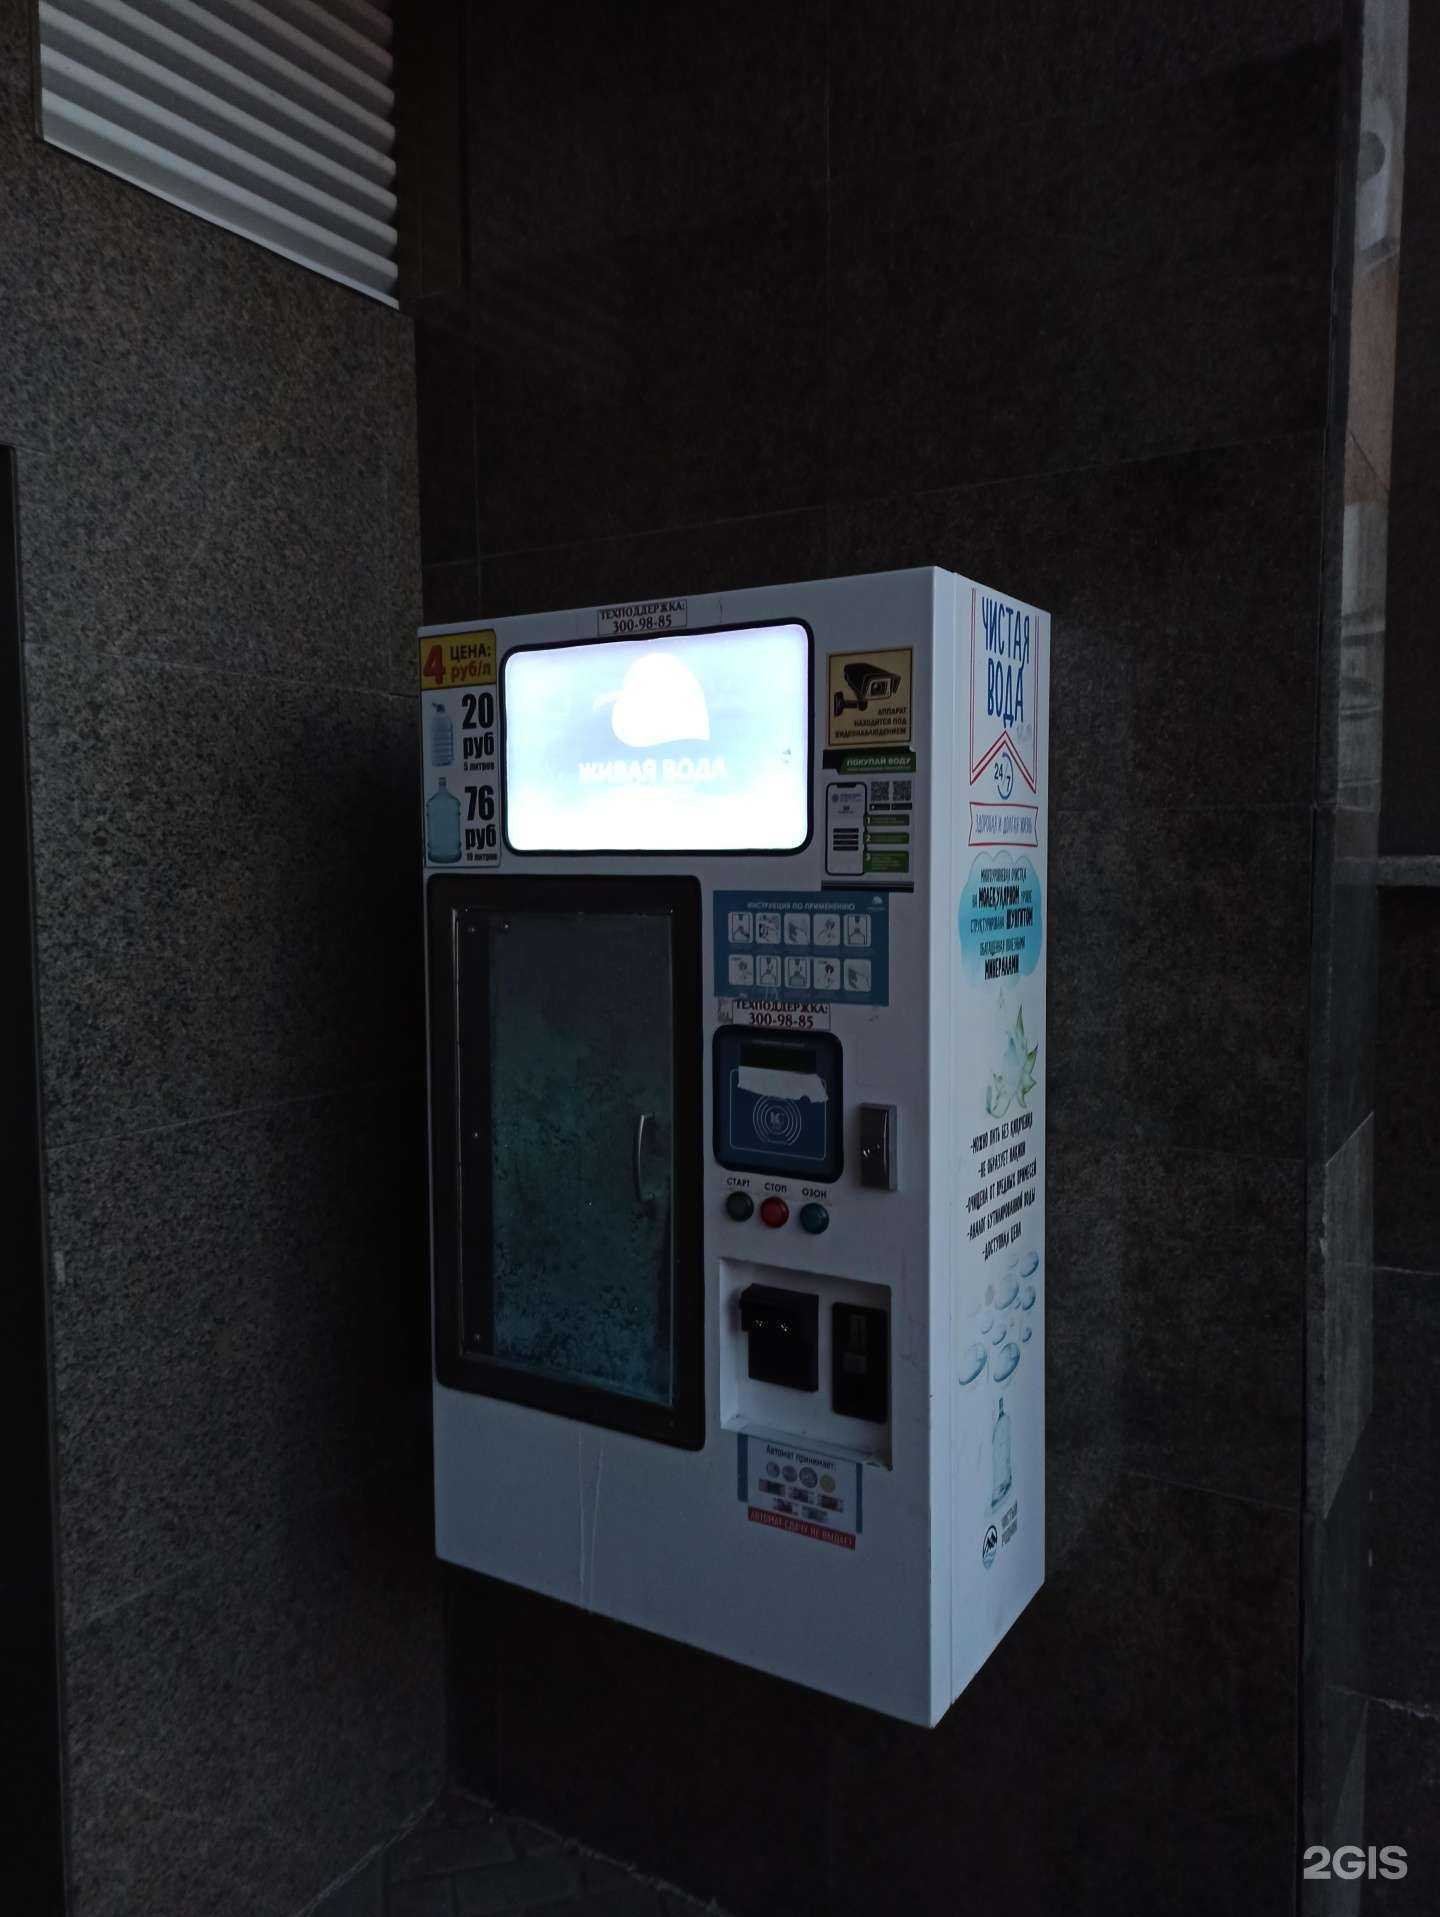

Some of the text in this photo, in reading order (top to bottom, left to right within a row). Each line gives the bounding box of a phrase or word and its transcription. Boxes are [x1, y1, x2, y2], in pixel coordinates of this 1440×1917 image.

[601, 601, 686, 620] ТЕХПОДДЕРЖКА:
[613, 614, 672, 633] 300-98-85
[982, 597, 1030, 666] ЧИСТАЯ
[423, 644, 446, 685] 4
[450, 643, 491, 662] ЦЕНА:
[451, 661, 491, 682] руб/л
[987, 658, 1024, 728] ВОДА
[462, 692, 494, 730] 20
[463, 732, 495, 759] руб
[465, 785, 495, 821] 76
[465, 824, 497, 850] руб
[750, 1012, 814, 1029] 300-98-85
[764, 1182, 787, 1193] СТОП
[802, 1188, 827, 1199] ОЗОН
